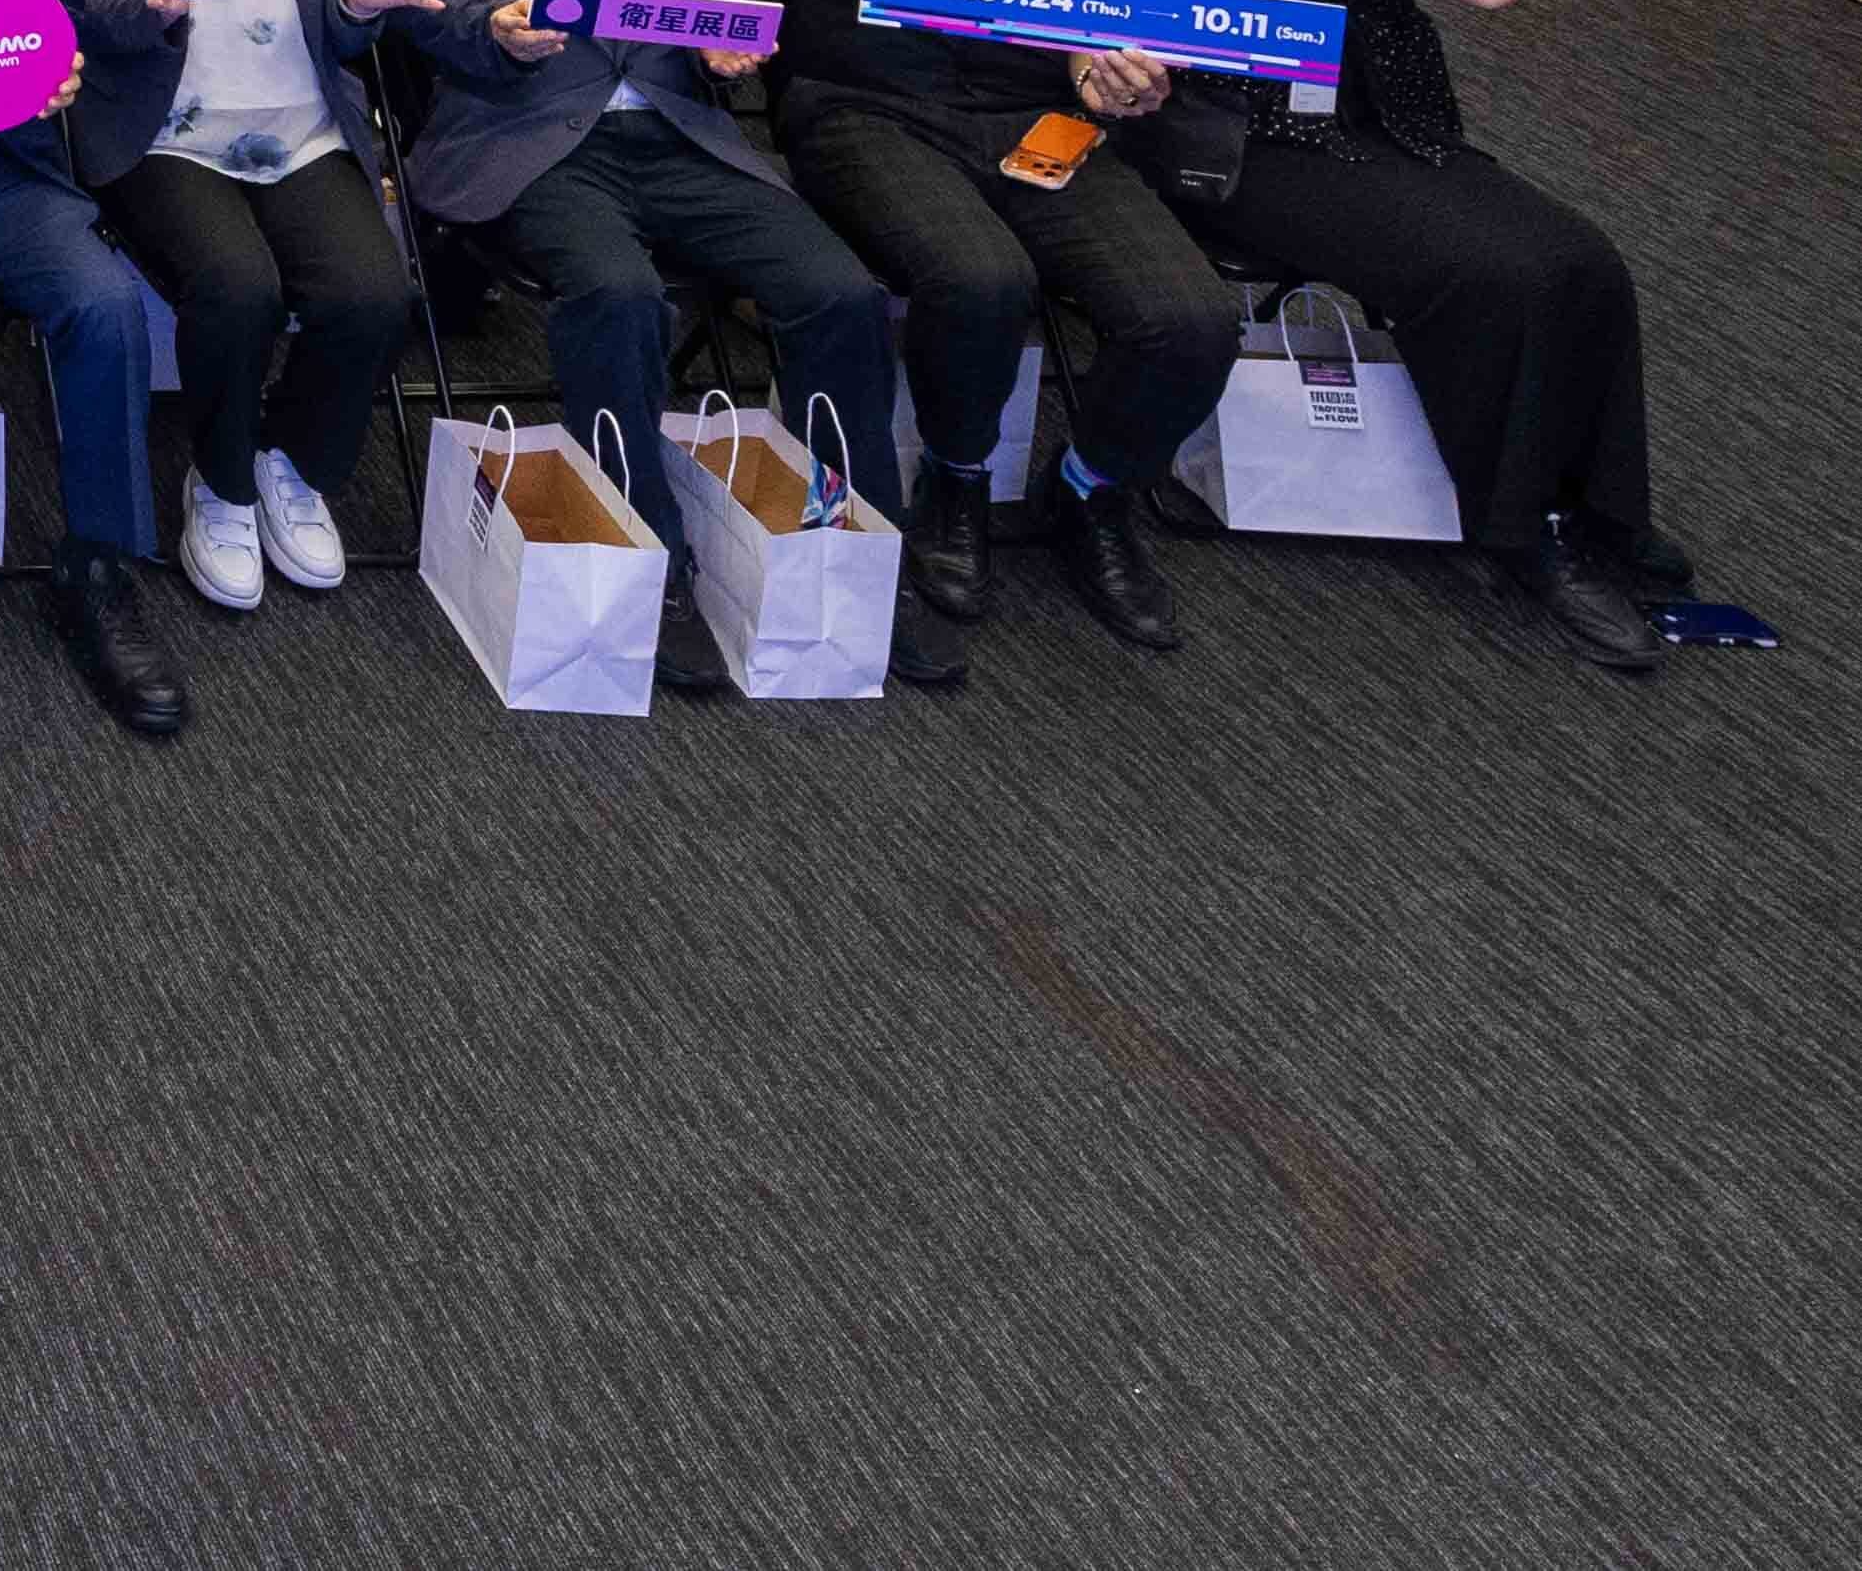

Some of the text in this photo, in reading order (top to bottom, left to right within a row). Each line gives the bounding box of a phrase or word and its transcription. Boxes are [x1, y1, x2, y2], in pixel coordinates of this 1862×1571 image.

[619, 2, 764, 42] 衛星展區
[1081, 0, 1131, 20] (Thu.)
[1190, 3, 1270, 40] 10.11
[1275, 25, 1327, 46] (Sun.)
